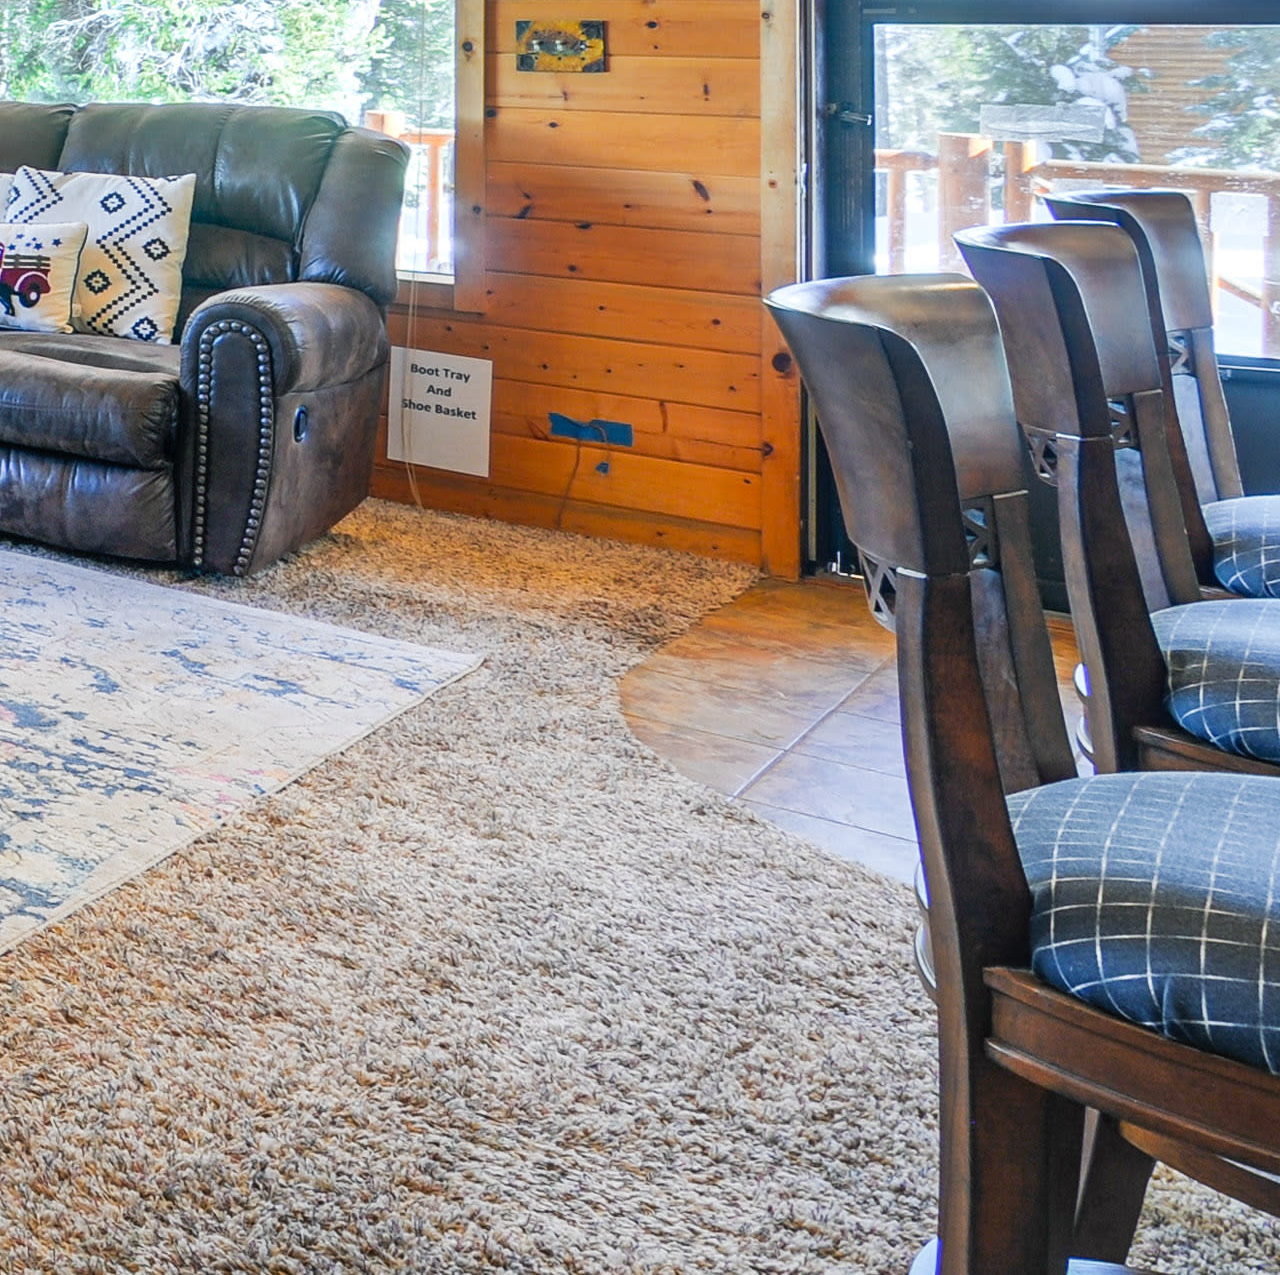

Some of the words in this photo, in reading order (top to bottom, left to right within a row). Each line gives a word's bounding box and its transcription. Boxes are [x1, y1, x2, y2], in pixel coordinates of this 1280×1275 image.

[411, 364, 440, 377] Boot
[443, 368, 471, 383] Tray
[427, 385, 452, 397] And
[402, 399, 431, 412] Shoe
[435, 405, 477, 420] Basket
